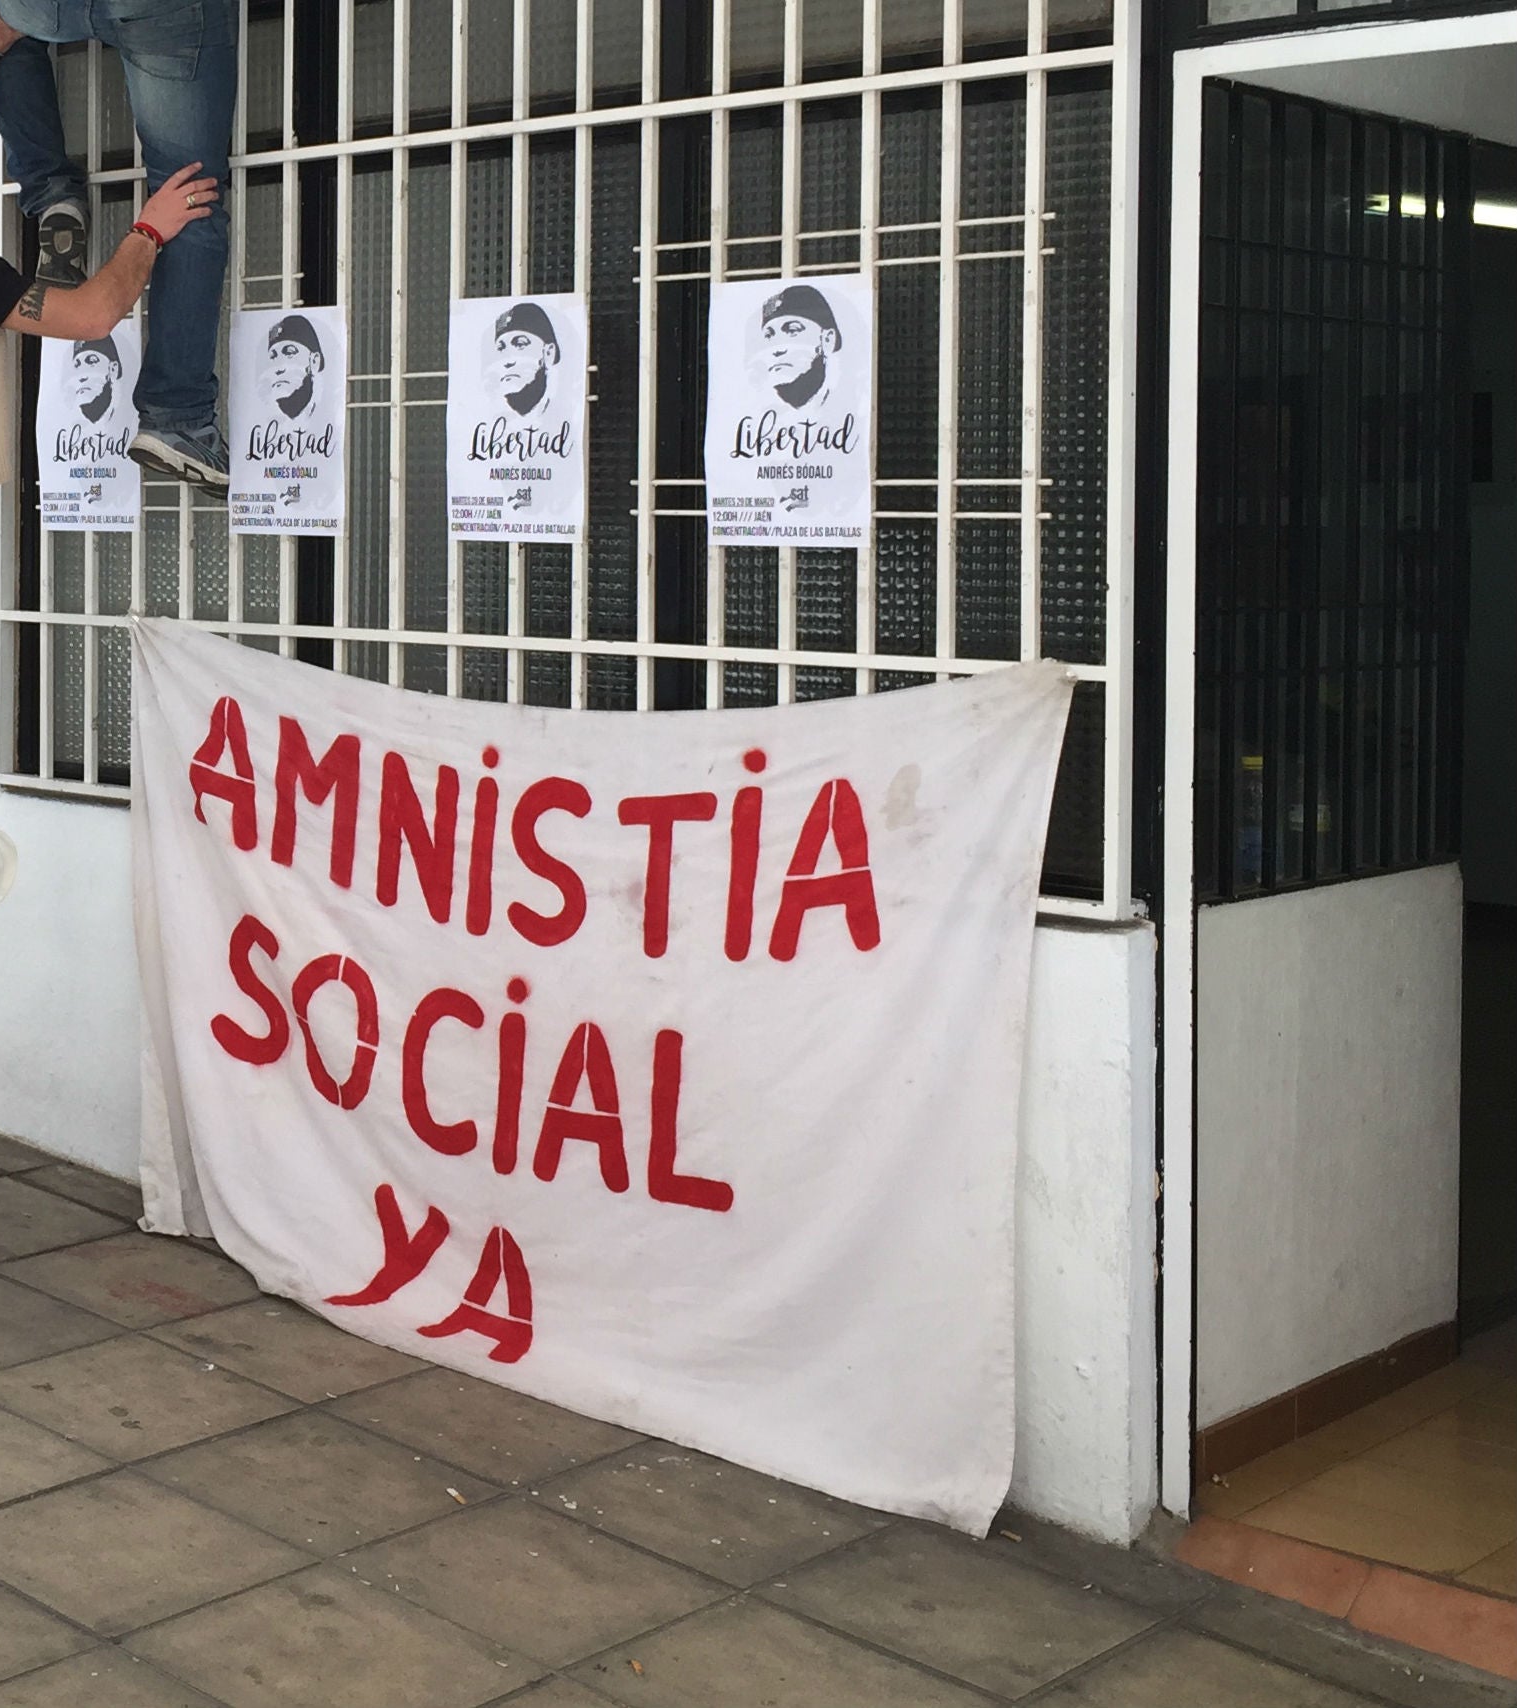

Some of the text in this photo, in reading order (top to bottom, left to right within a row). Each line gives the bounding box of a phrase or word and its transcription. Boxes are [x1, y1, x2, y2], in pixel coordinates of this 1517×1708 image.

[245, 419, 336, 461] Libertad
[467, 416, 573, 462] Libertad
[729, 409, 860, 459] Libertad
[53, 423, 131, 462] Libertad
[489, 467, 520, 480] ANDRÉS
[756, 463, 833, 479] ANDRÉS BÓDALO
[712, 497, 735, 507] MARTES
[745, 497, 754, 507] DE
[754, 497, 775, 507] MARZO
[712, 511, 738, 521] 12:00H
[754, 509, 772, 521] JAÉN
[294, 518, 300, 528] DE
[301, 518, 311, 528] LAS
[524, 523, 532, 533] DE
[533, 524, 544, 534] LAS
[545, 524, 576, 534] BATALLAS
[799, 526, 808, 537] DE
[810, 526, 823, 537] LAS
[825, 526, 862, 538] BATALLAS
[324, 1183, 534, 1364] YA
